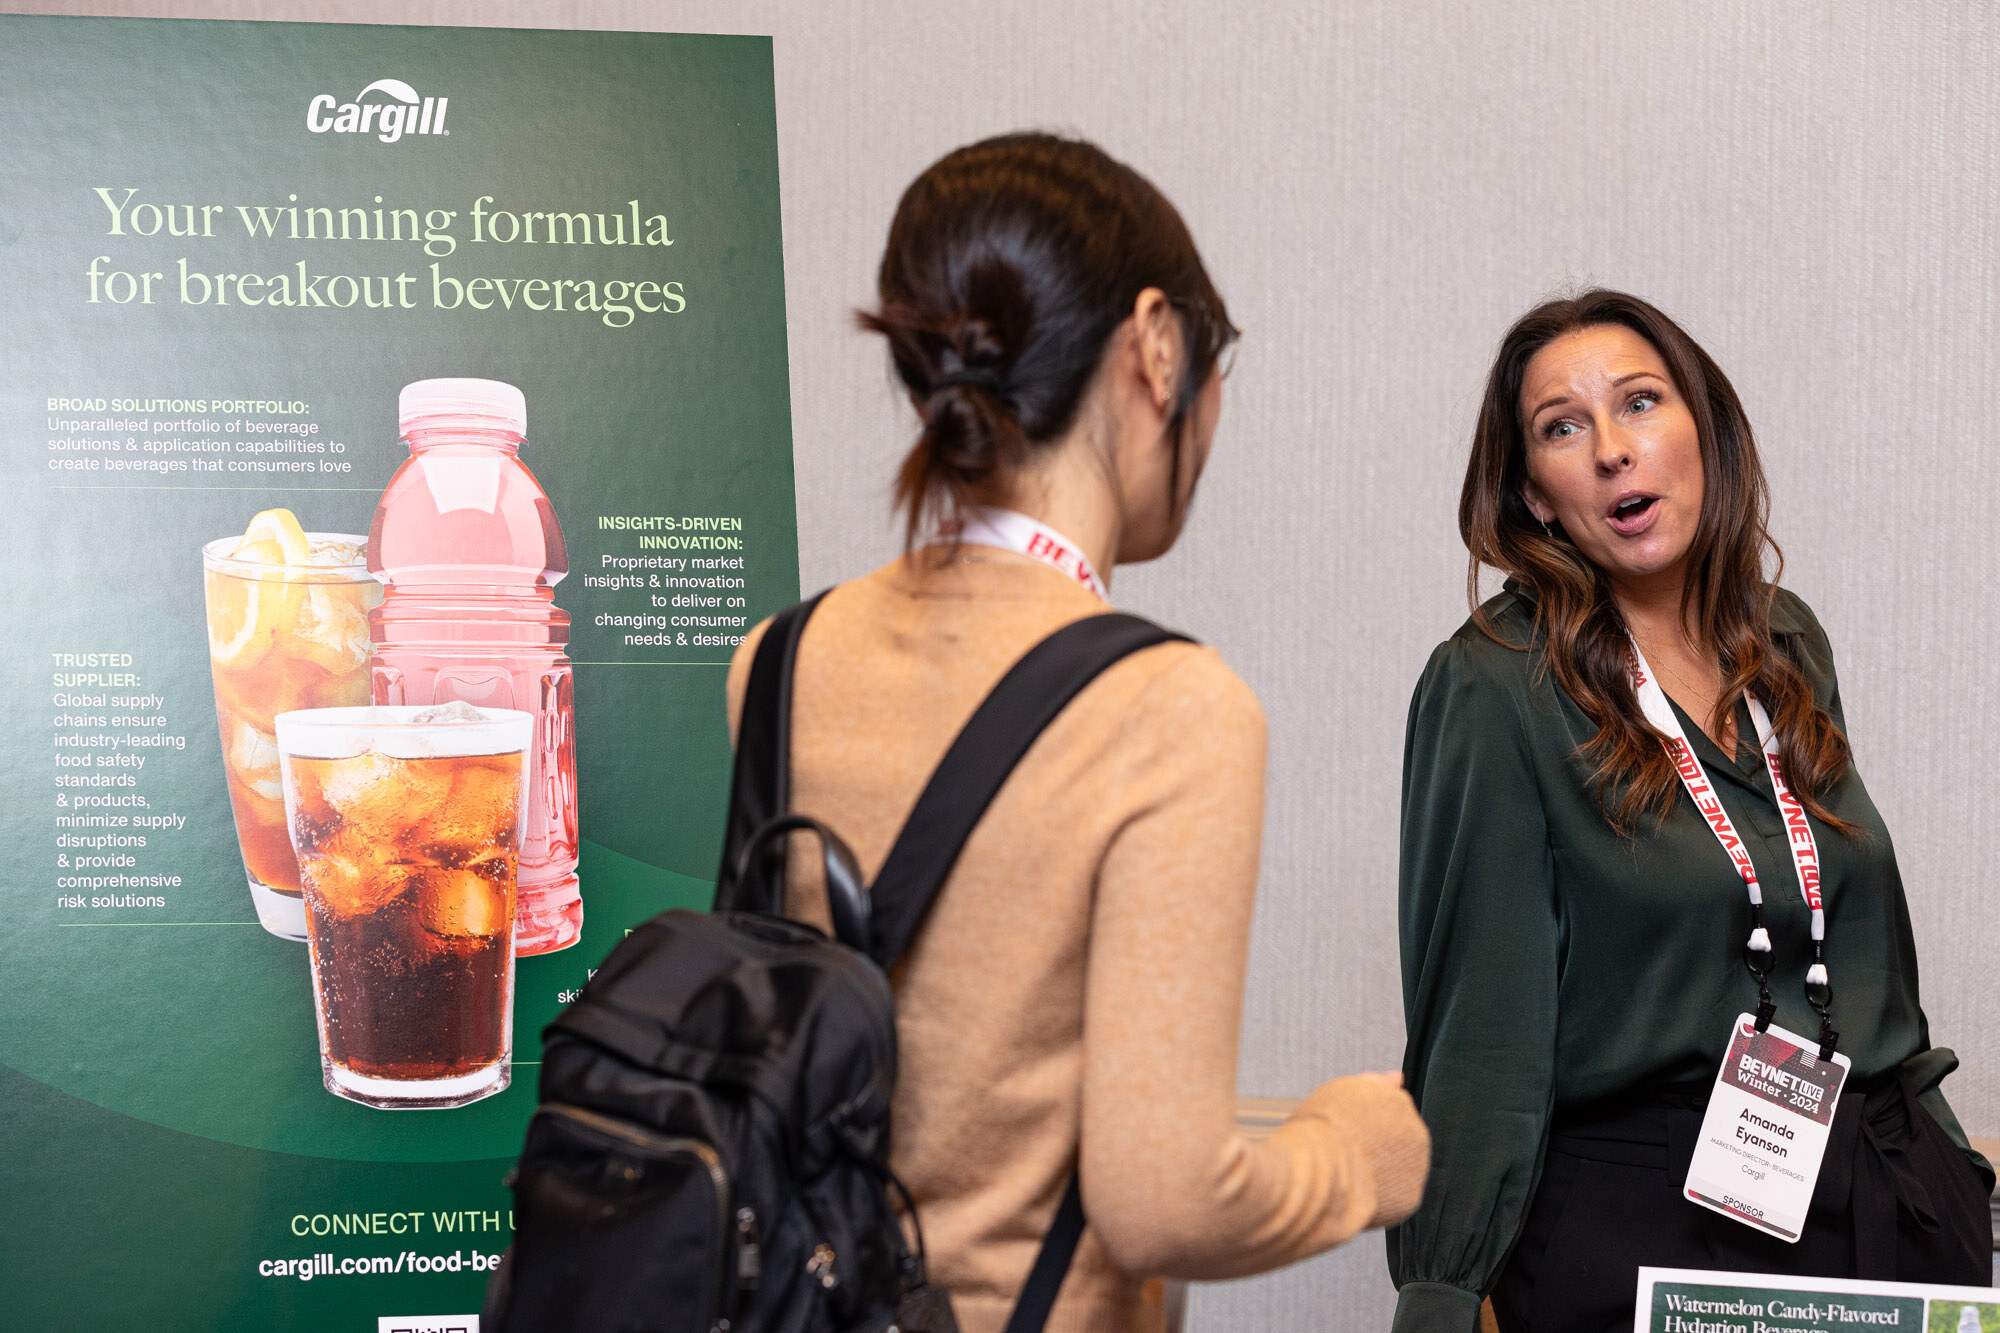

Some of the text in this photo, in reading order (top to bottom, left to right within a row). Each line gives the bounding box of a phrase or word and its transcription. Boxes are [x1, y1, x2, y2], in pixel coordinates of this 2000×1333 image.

[306, 93, 449, 143] Cargill
[92, 187, 674, 257] Your winning formula
[85, 256, 687, 327] for breakout beverages
[47, 398, 310, 414] BROAD SOLUTIONS PORTFOLIO:
[47, 417, 319, 436] Unparalleled portfolio of beverage
[47, 437, 345, 455] solutions & application capabilities to
[48, 456, 352, 474] create beverages that consumers love
[598, 516, 742, 531] INSIGHTS-DRIVEN
[639, 536, 743, 550] INNOVATION:
[601, 554, 744, 572] Proprietary market
[584, 574, 745, 591] insights & innovation
[651, 593, 746, 608] to deliver on
[595, 613, 747, 630] changing consumer
[624, 632, 748, 646] needs & desires
[52, 653, 133, 667] TRUSTED
[53, 673, 141, 687] SUPPLIER:
[54, 693, 164, 710] Global supply
[54, 713, 167, 727] chains ensure
[54, 733, 186, 750] industry-leading
[54, 753, 146, 770] food safety
[55, 773, 136, 787] standards
[56, 793, 150, 810] & products,
[56, 813, 186, 830] minimize supply
[56, 833, 146, 850] disruptions
[57, 853, 136, 870] & provide
[57, 873, 182, 890] comprehensive
[57, 893, 165, 908] risk solutions
[1737, 1069, 1820, 1114] Winter 2024
[1739, 1108, 1795, 1140] Amanda
[1735, 1126, 1788, 1158] Eyanson
[1741, 1164, 1766, 1181] Cargill
[1772, 1164, 1805, 1182] BEVERAGES
[1722, 1195, 1764, 1219] SPONSOR
[291, 1212, 425, 1236] CONNECT
[432, 1211, 500, 1233] WITH
[258, 1250, 501, 1281] cargill.com/food-be
[1664, 1293, 1900, 1326] Watermelon Candy-Flavored
